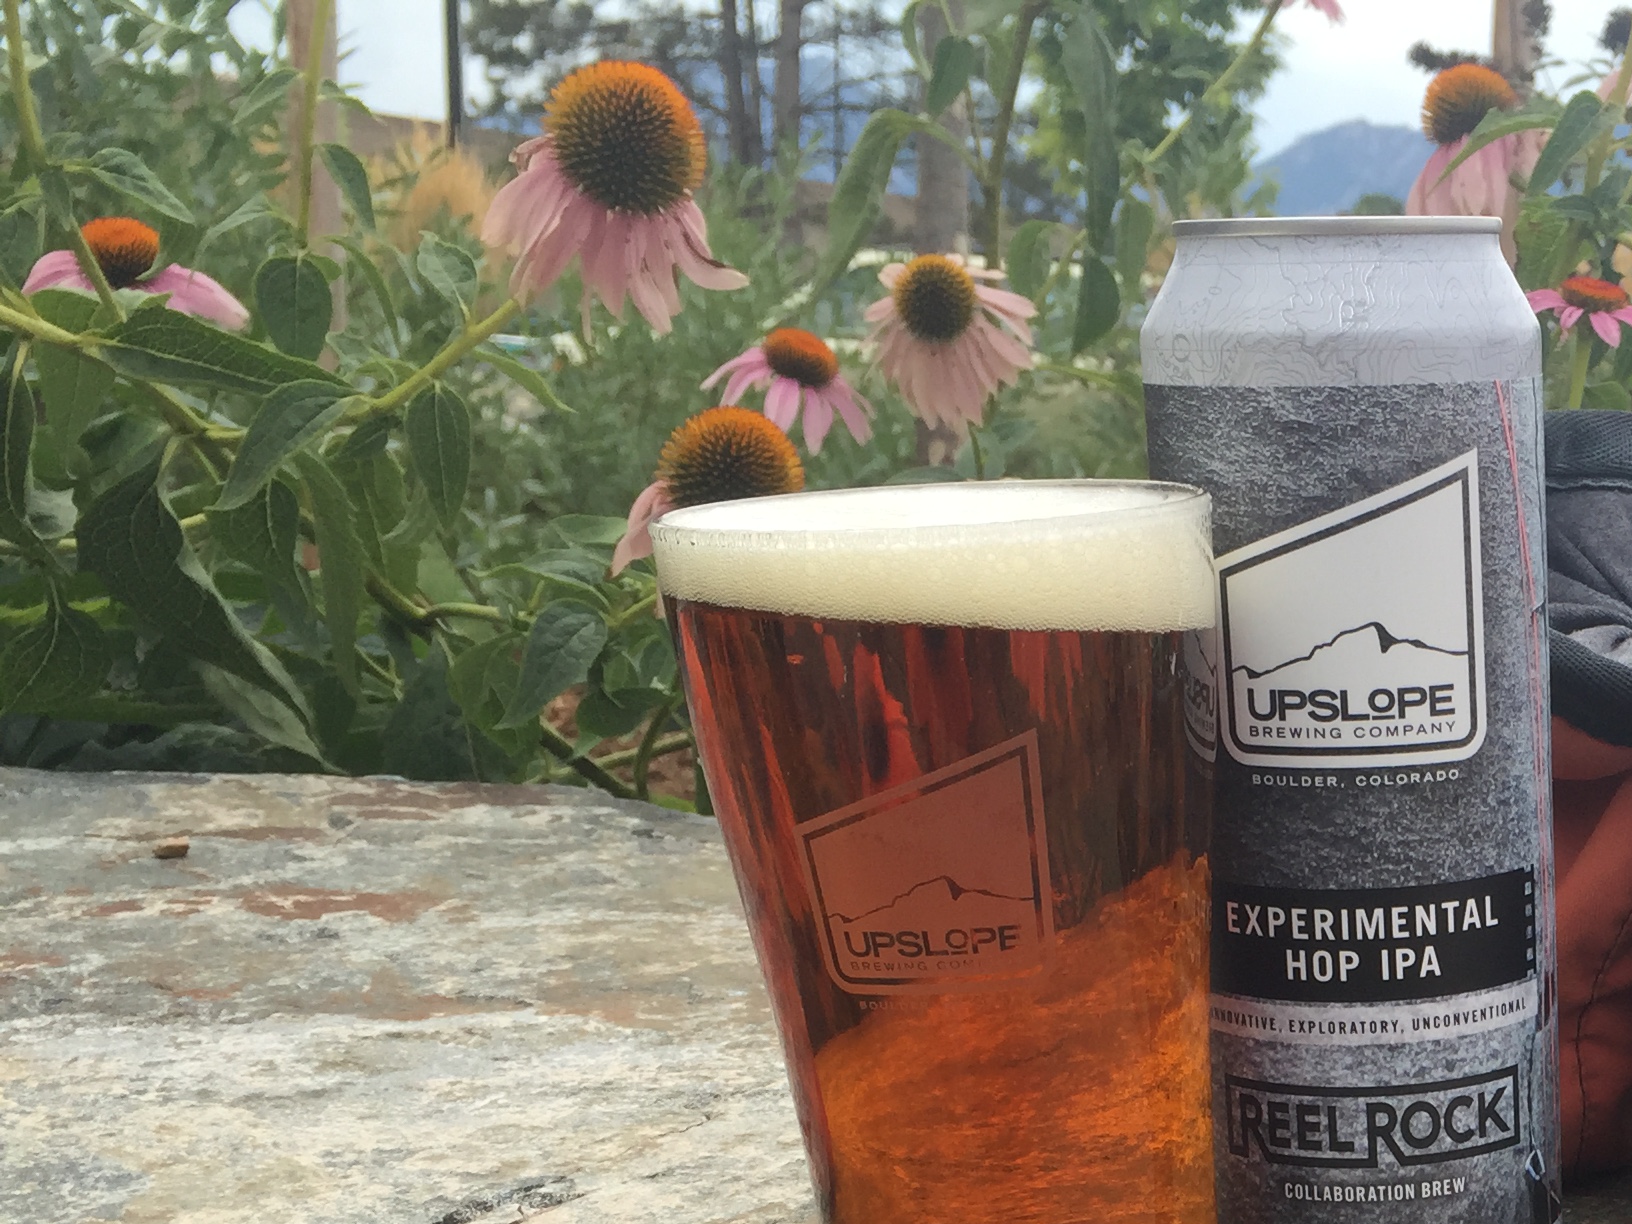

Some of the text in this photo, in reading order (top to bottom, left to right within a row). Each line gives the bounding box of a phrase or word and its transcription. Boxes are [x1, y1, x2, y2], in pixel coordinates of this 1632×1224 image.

[1247, 684, 1456, 723] UPSLOPE
[1249, 721, 1456, 739] BREWING COMPANY
[1252, 769, 1460, 788] BOULDER, COLORADO
[1226, 895, 1499, 941] EXPERIMENTAL
[844, 925, 1022, 958] UPSLOPE
[850, 961, 928, 972] BREWING
[1285, 945, 1442, 982] HOP IPA
[1289, 1018, 1405, 1035] EXPLORATORY,
[1411, 997, 1527, 1032] UNCONVENTIONAL
[1239, 1086, 1511, 1160] REEL ROCK
[1285, 1177, 1467, 1202] COLLABORATION BREW
